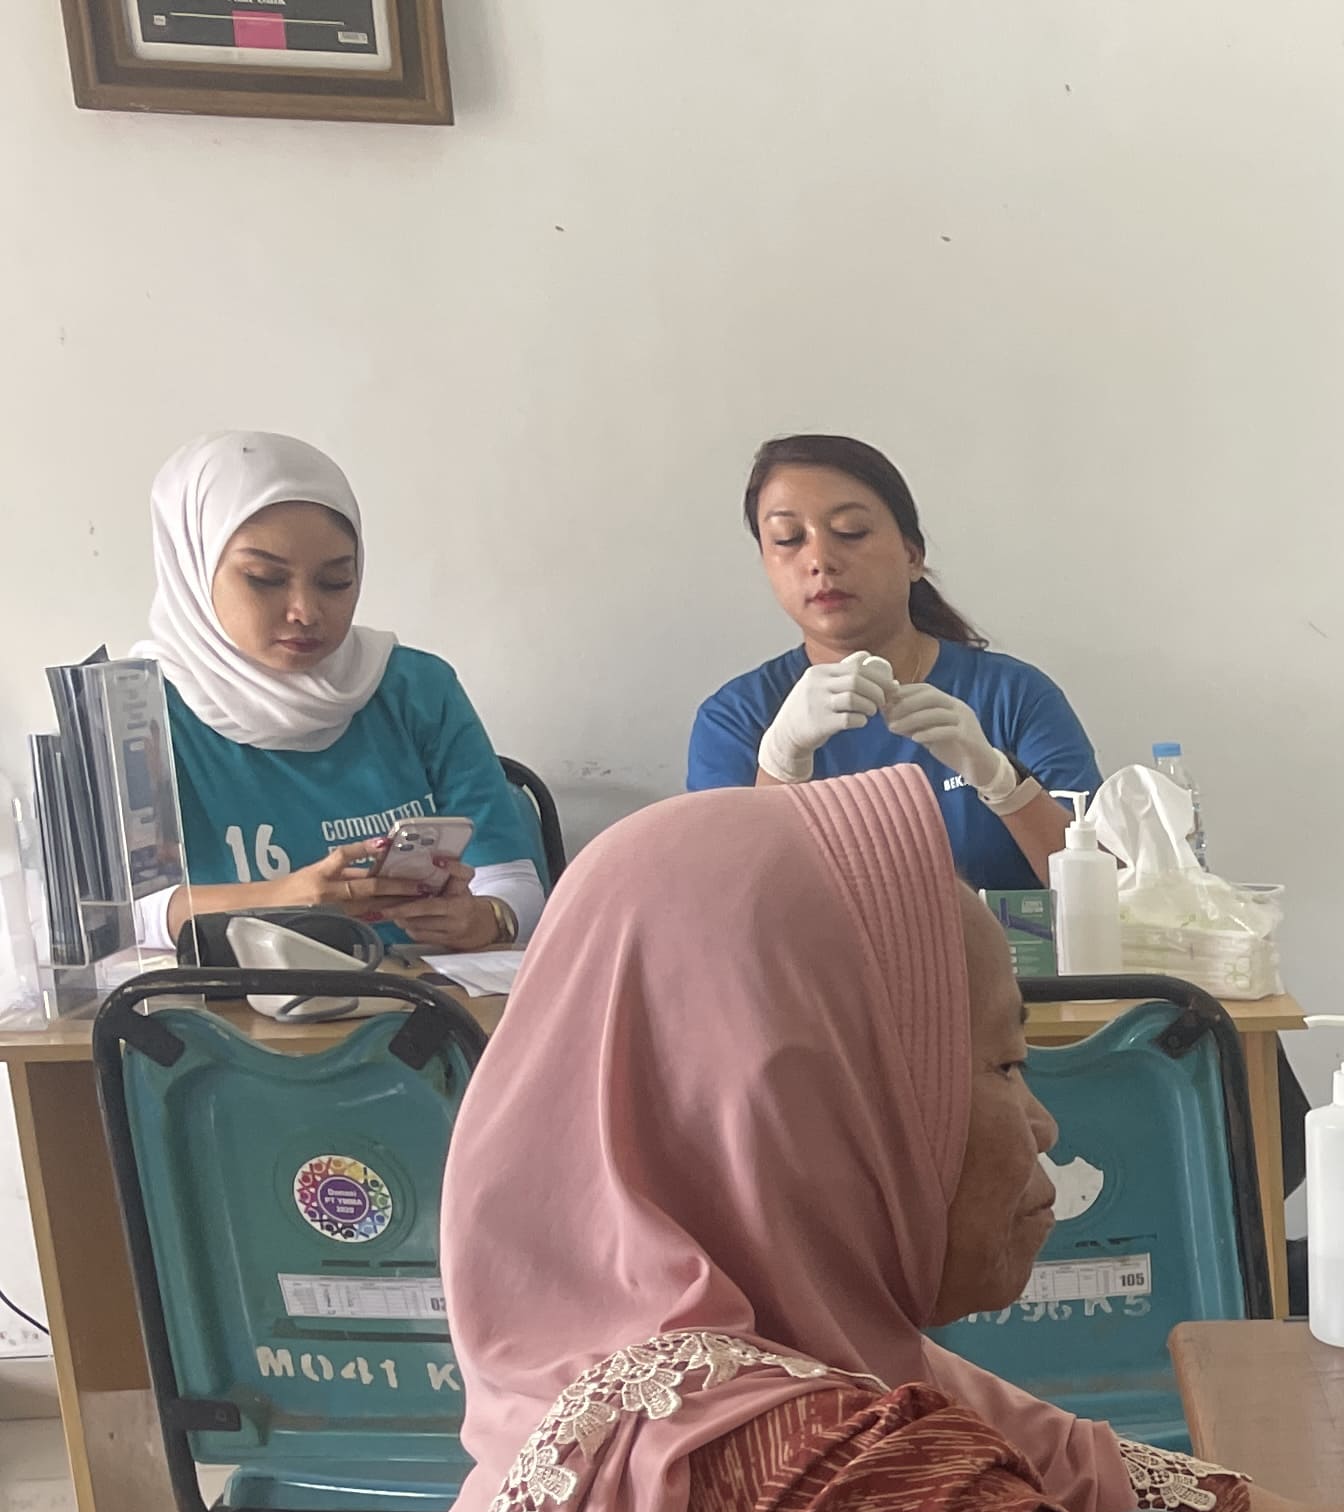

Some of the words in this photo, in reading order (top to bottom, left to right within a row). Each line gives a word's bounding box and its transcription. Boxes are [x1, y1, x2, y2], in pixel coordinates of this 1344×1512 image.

[943, 775, 967, 792] BEK
[225, 824, 291, 883] 16
[1119, 1272, 1145, 1287] 105
[255, 1346, 399, 1388] M041
[426, 1362, 461, 1391] K
